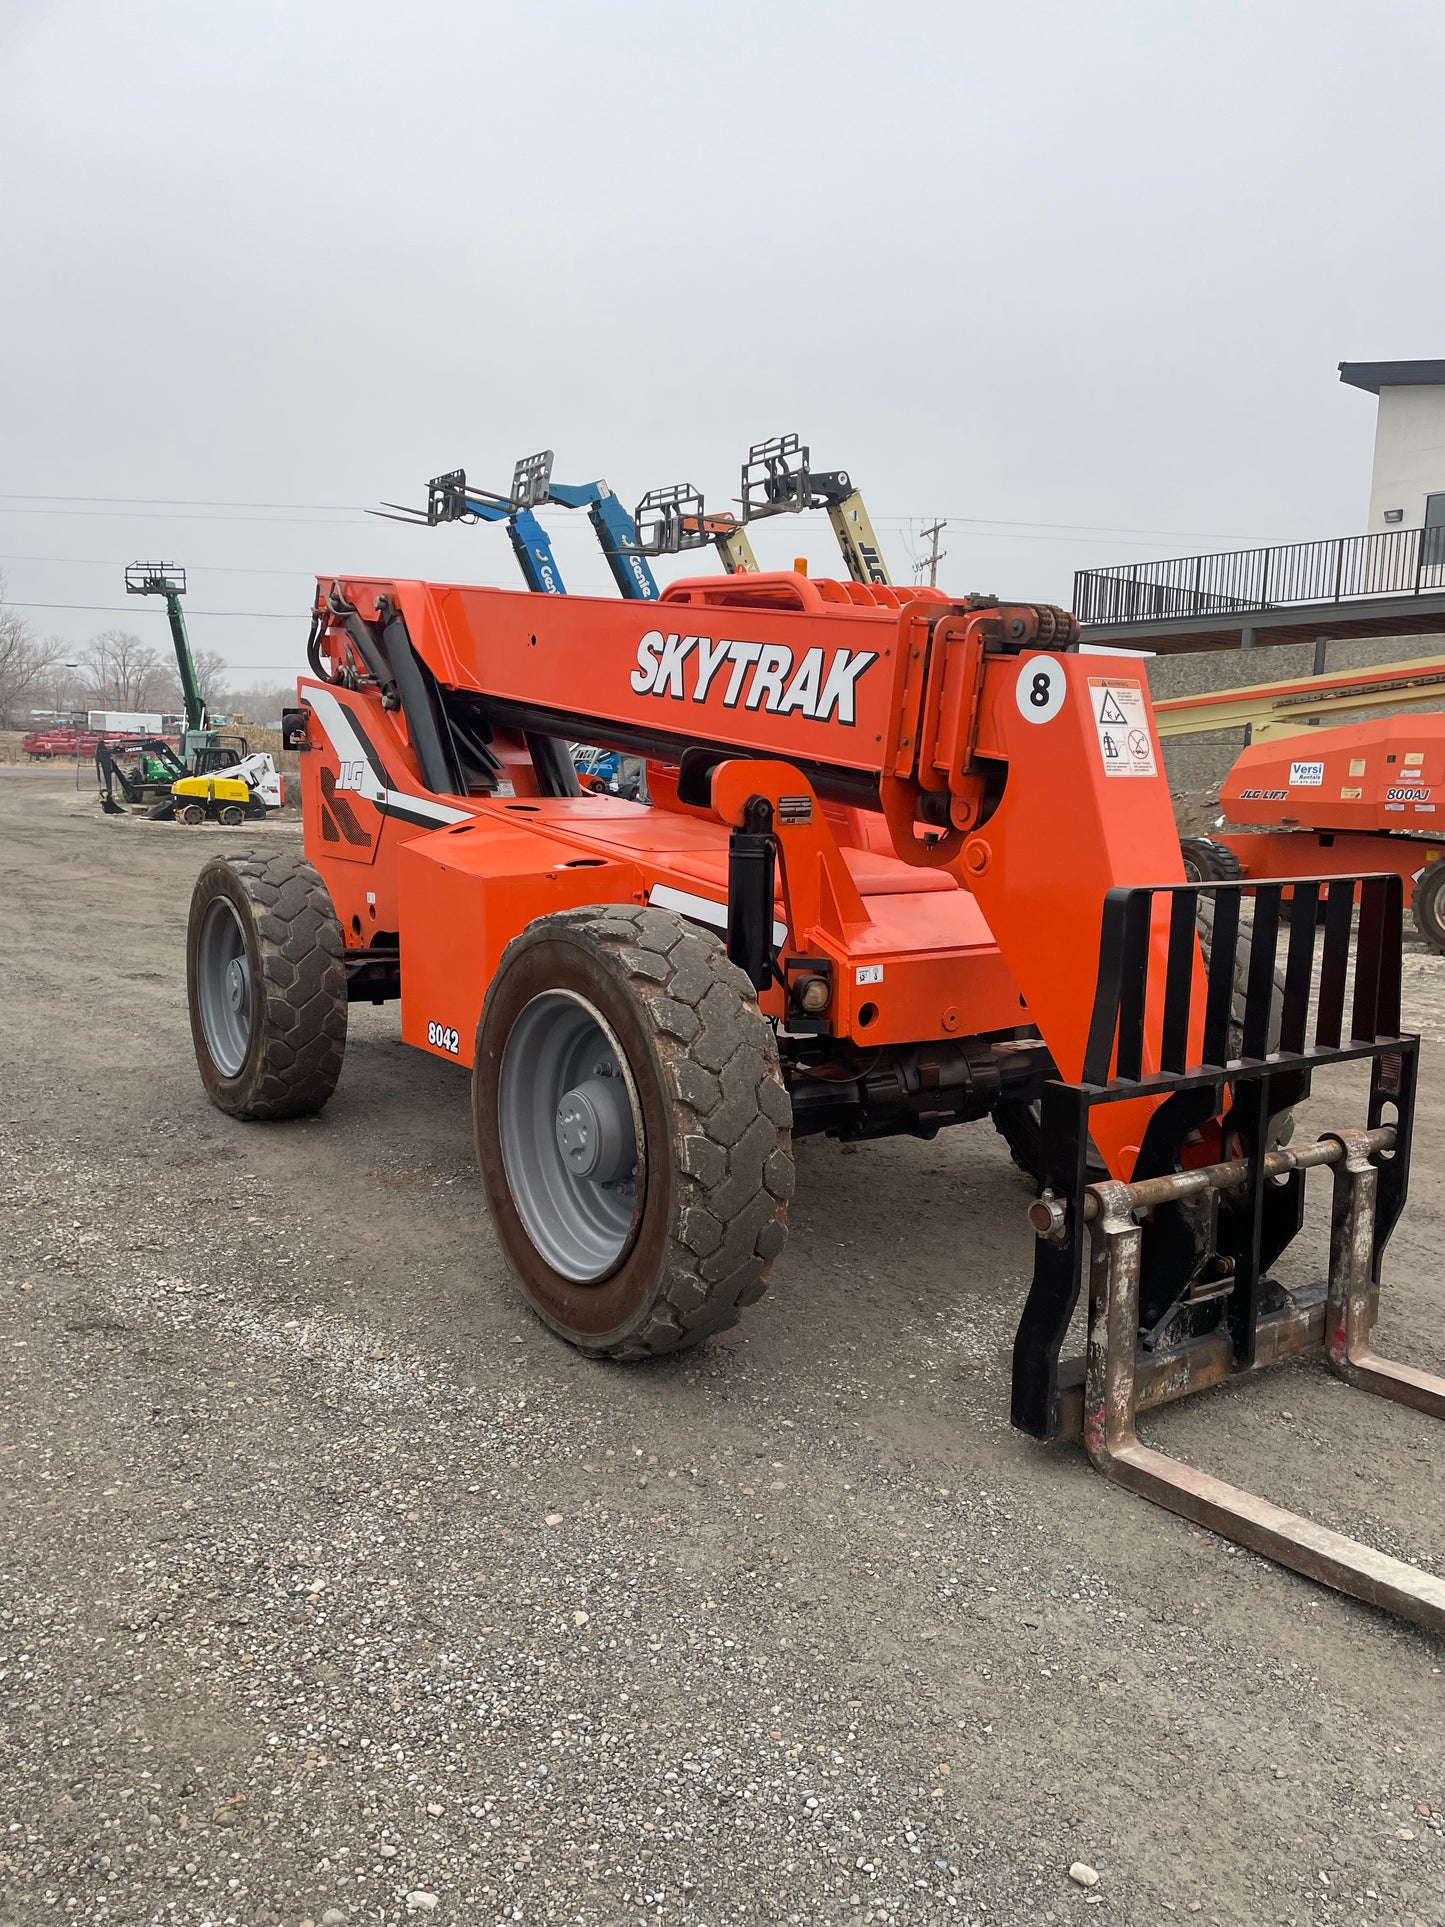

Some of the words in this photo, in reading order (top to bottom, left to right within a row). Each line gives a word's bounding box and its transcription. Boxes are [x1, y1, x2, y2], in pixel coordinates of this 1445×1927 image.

[541, 565, 560, 594] Gen
[629, 556, 651, 598] Genie
[858, 542, 887, 585] JLG
[630, 630, 879, 727] SKYTRAK
[1030, 672, 1051, 707] 8
[335, 761, 364, 791] JLG
[1293, 764, 1322, 774] Versi
[1240, 790, 1262, 799] JLG
[1262, 790, 1288, 800] LIFT
[1386, 788, 1430, 801] 800AJ
[427, 1020, 460, 1055] 8042
